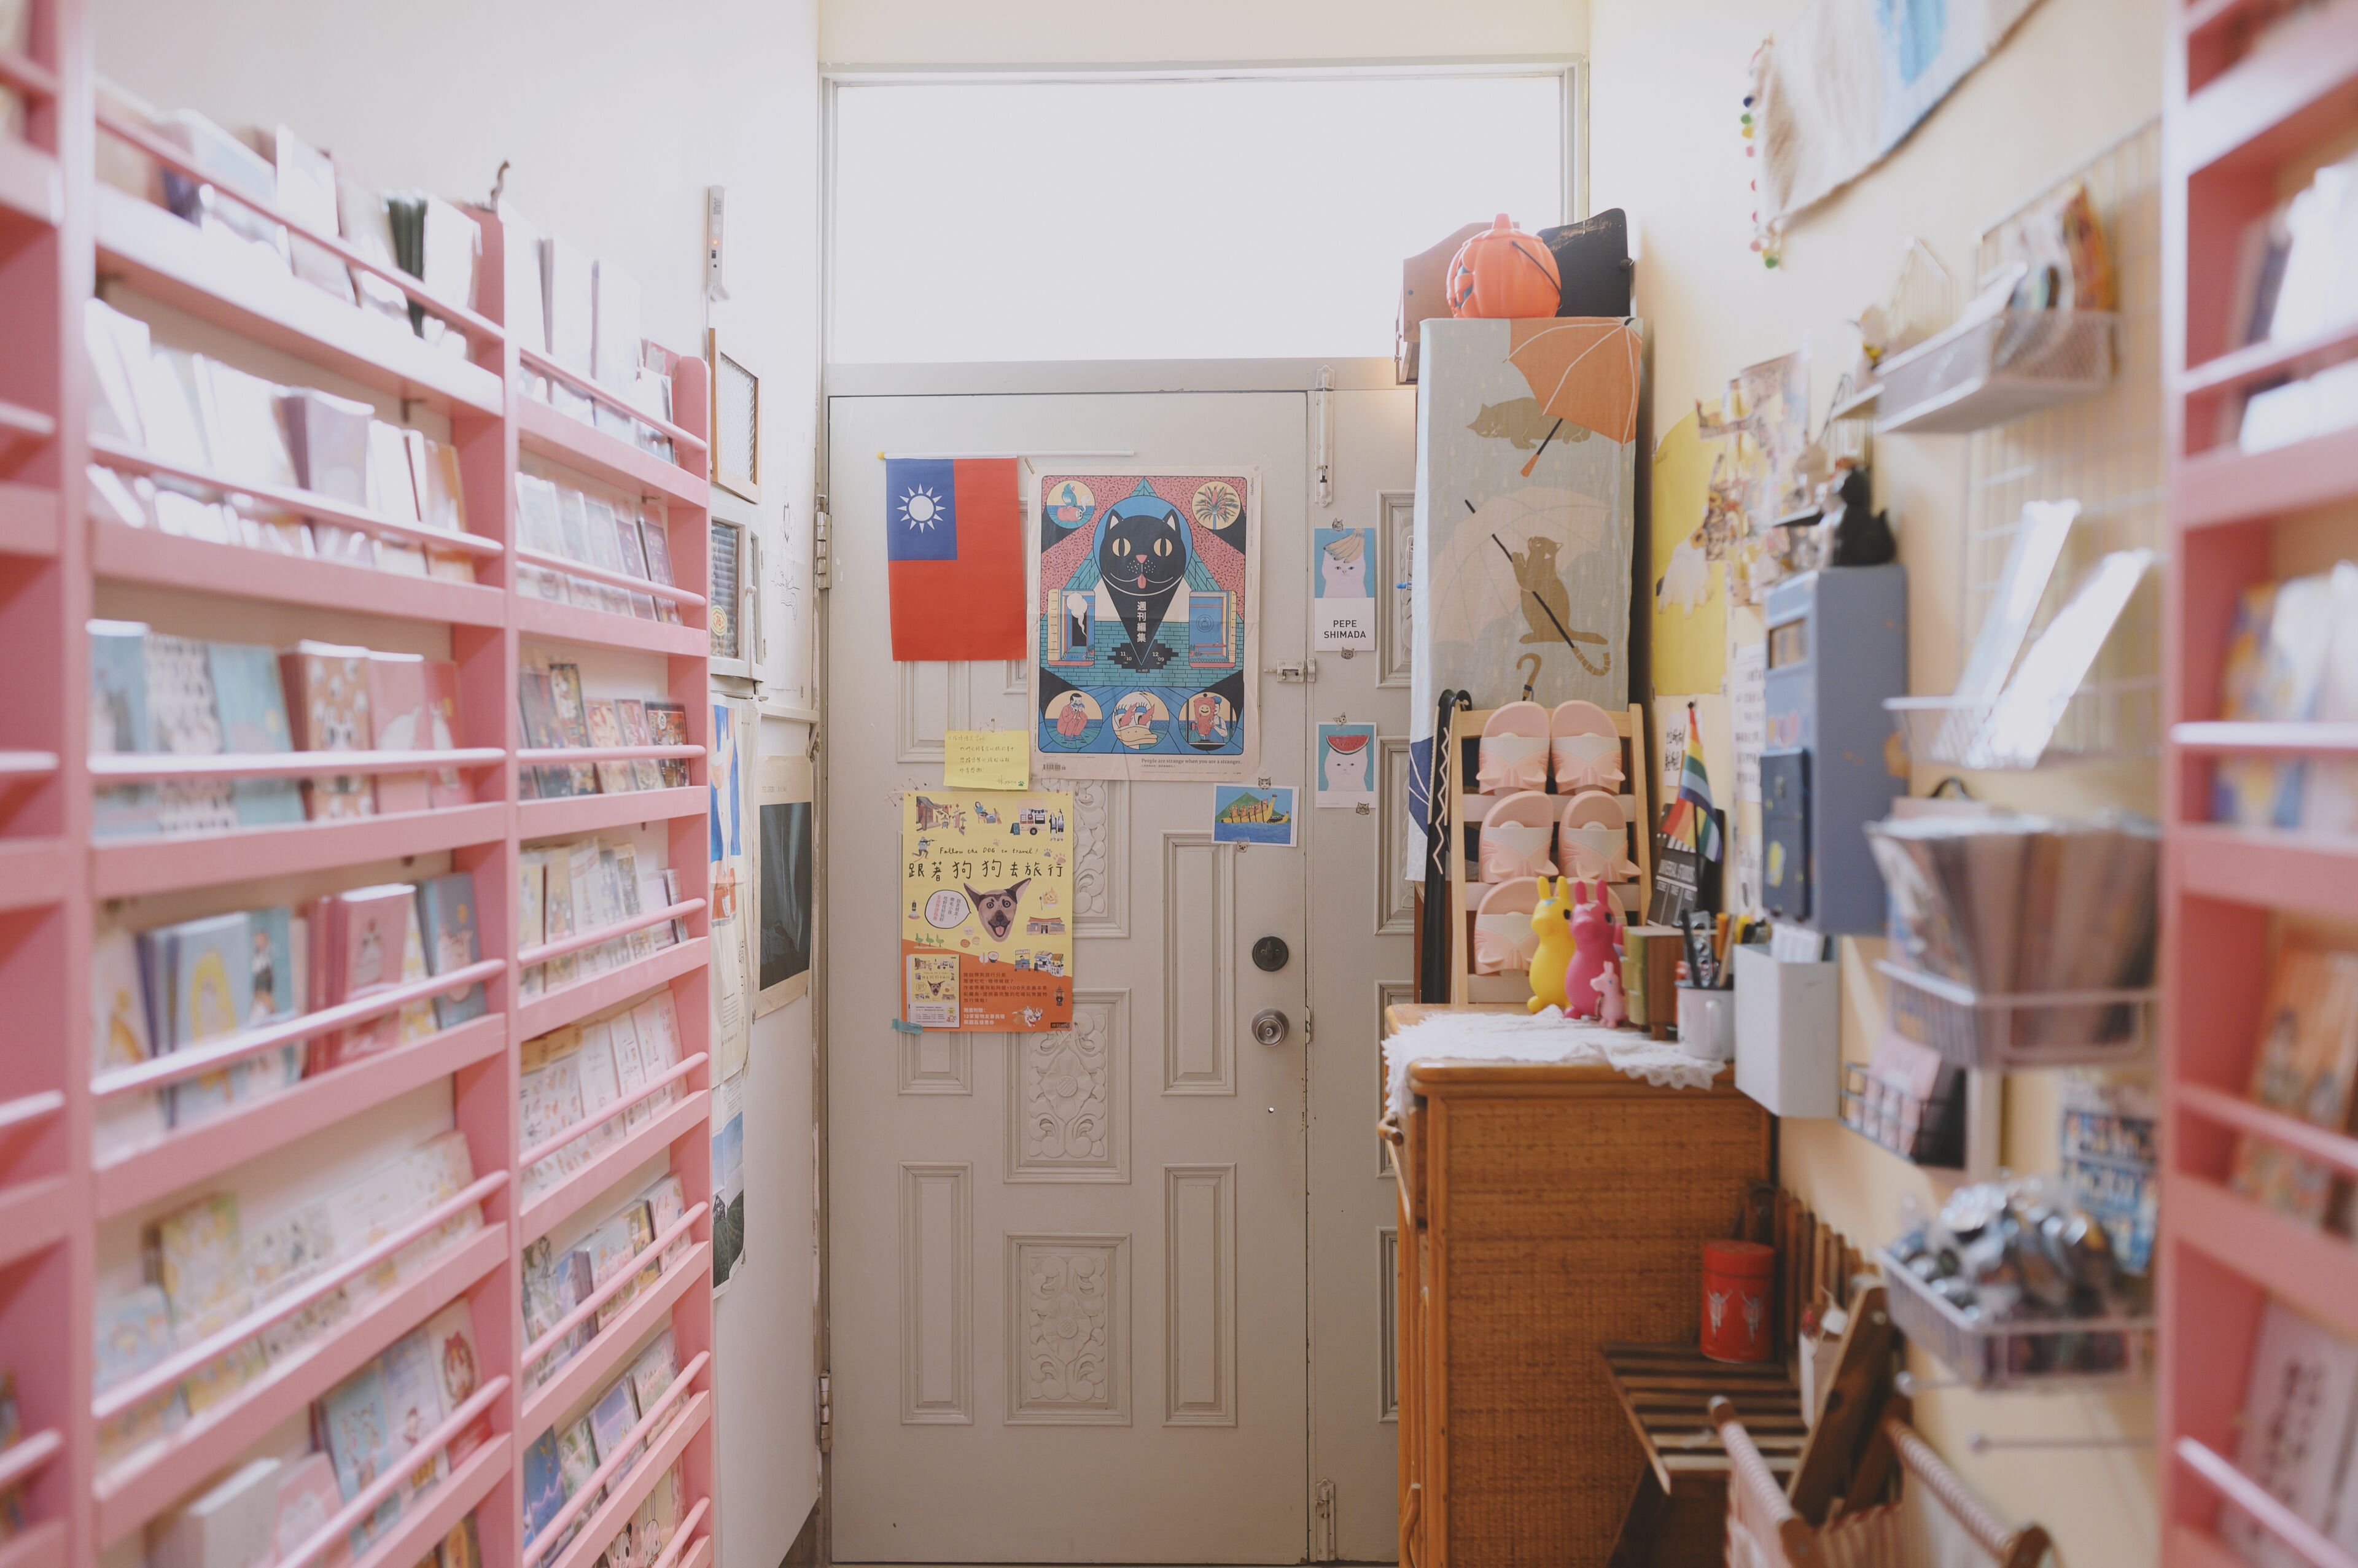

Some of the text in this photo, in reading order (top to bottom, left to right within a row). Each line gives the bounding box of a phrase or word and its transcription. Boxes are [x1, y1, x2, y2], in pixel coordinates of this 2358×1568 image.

[1137, 601, 1146, 643] 週刊編集
[908, 859, 1064, 882] 跟著狗狗去旅行
